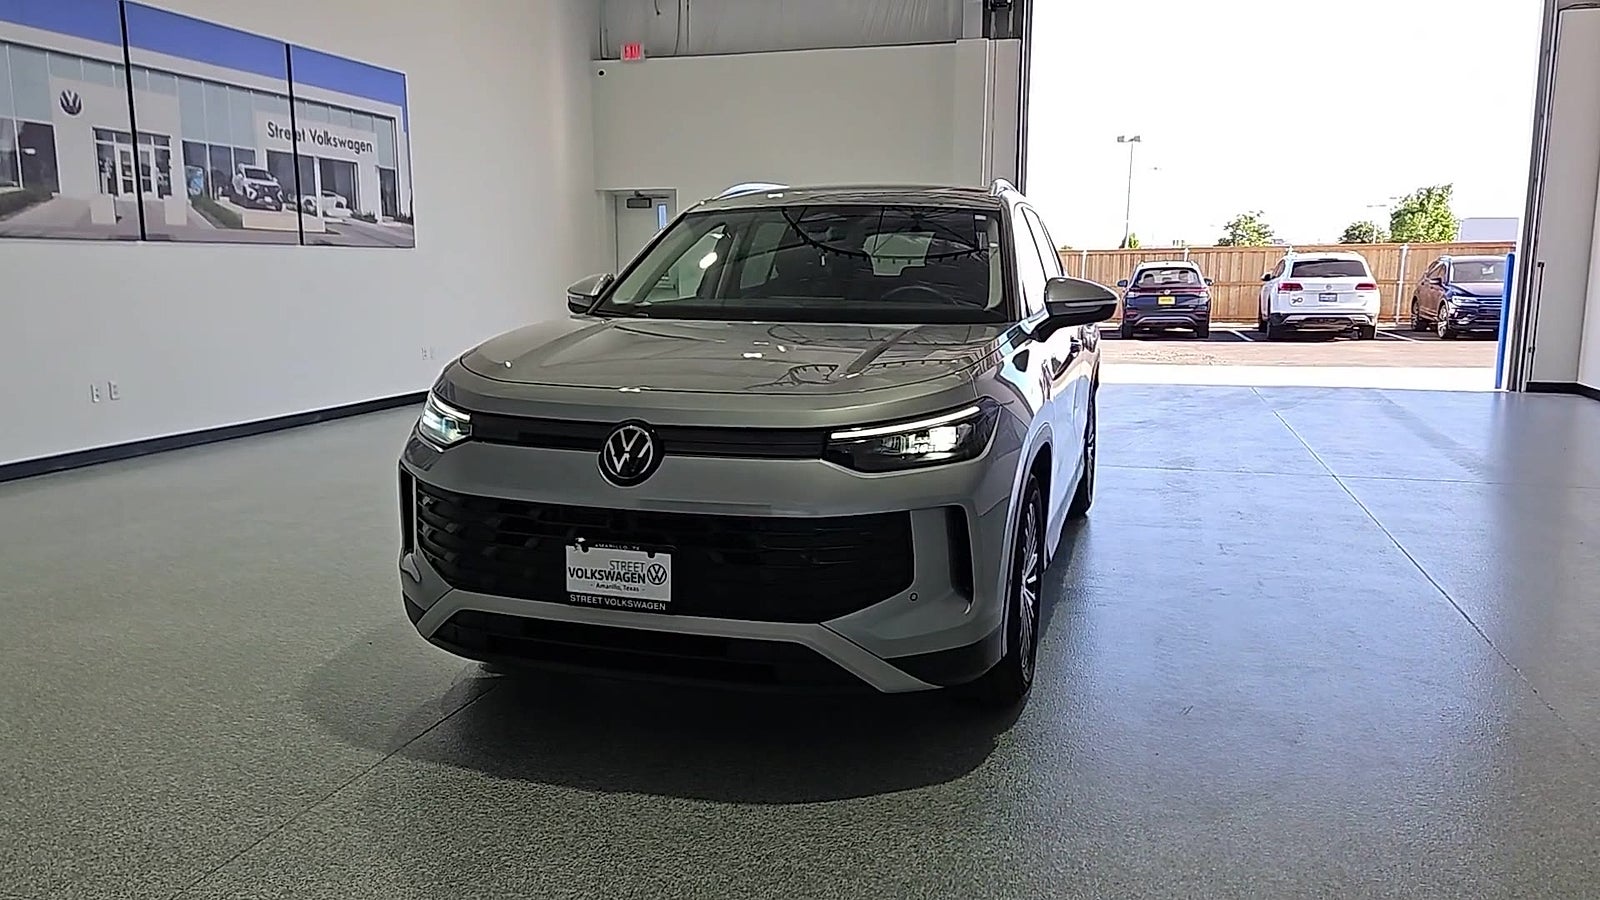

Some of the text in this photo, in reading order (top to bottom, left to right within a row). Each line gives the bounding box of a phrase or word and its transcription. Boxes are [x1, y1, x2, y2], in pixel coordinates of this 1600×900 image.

[267, 121, 374, 154] Street Volkswagen
[568, 566, 646, 584] VOLKSWAGEN
[609, 560, 646, 573] STREET
[595, 582, 640, 592] Amarillo, Texas
[570, 594, 666, 611] STREET VOLKSWAGEN
